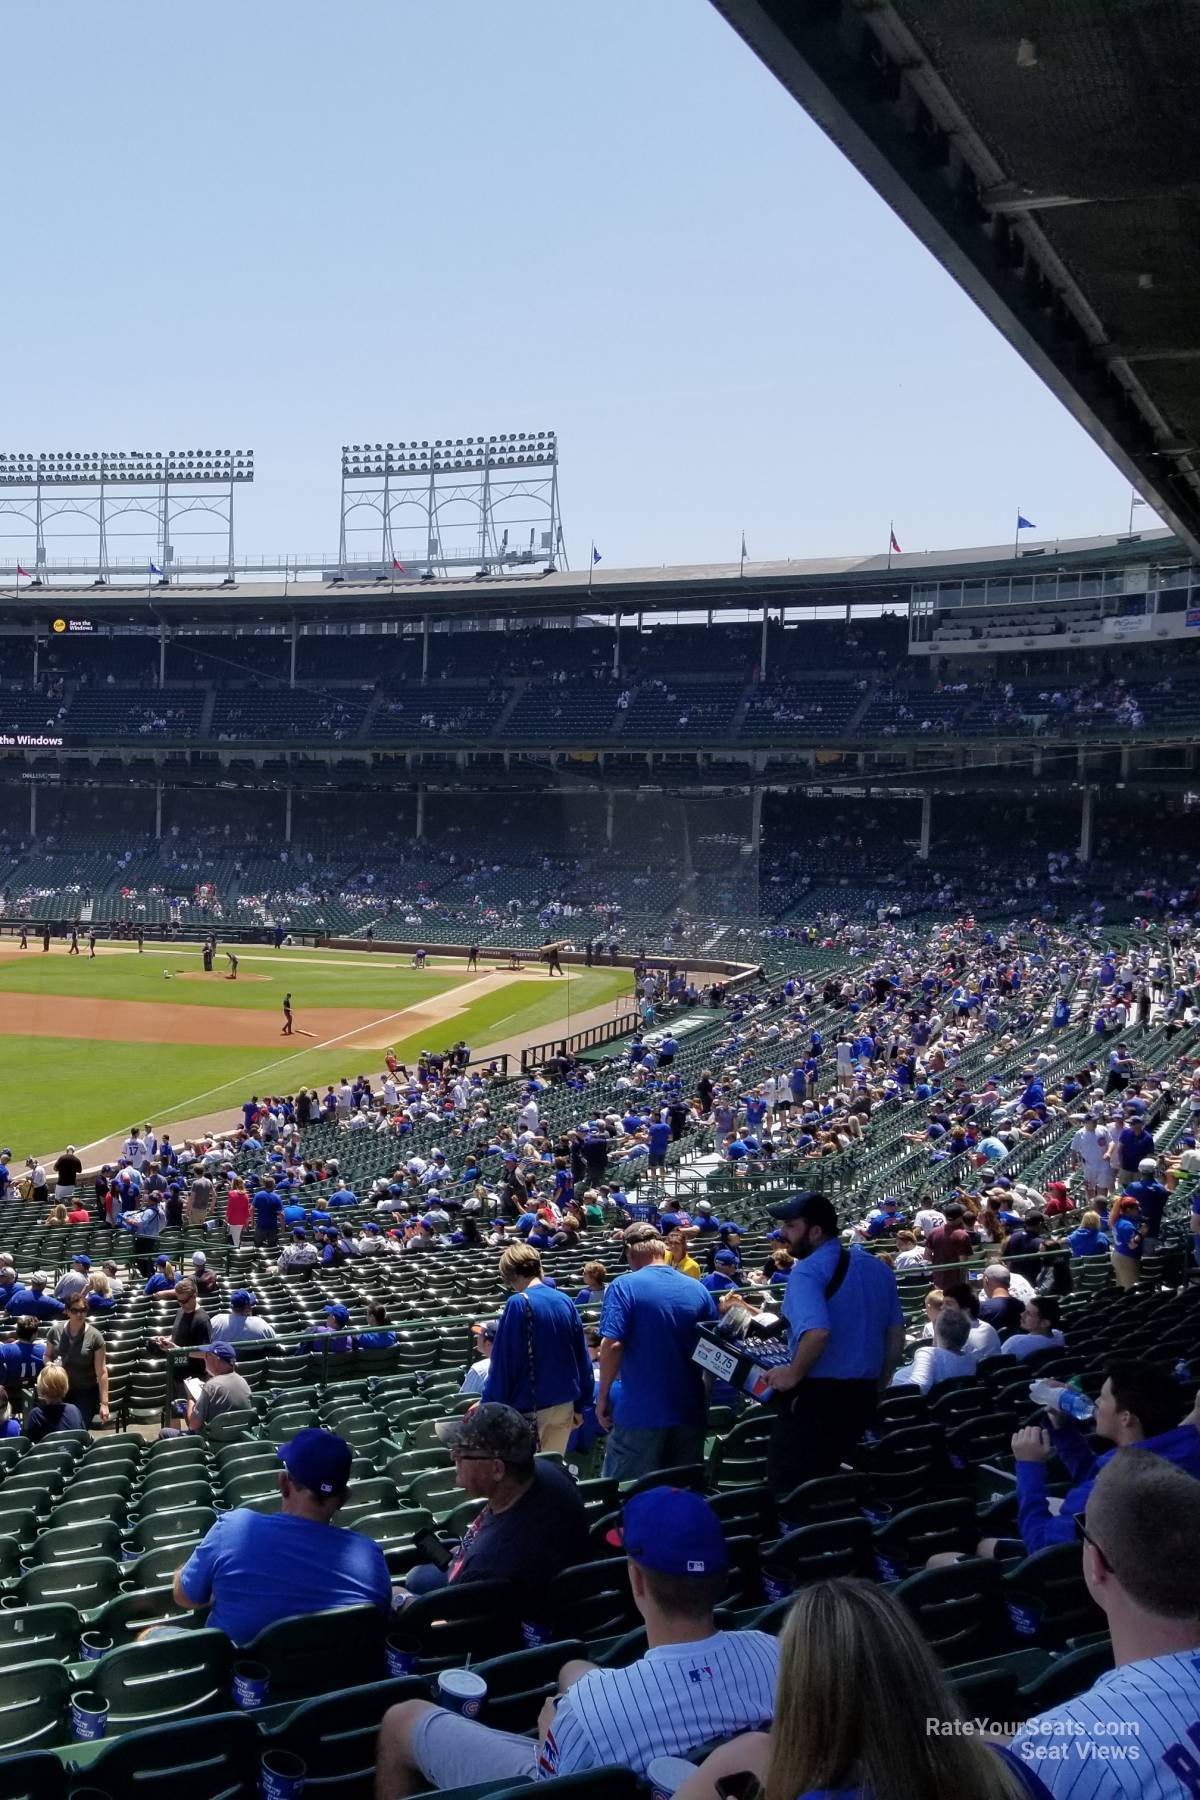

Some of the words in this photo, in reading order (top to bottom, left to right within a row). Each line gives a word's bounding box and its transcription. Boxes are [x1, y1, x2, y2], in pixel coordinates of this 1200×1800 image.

[17, 736, 63, 746] Windows
[714, 1351, 734, 1369] 9.75
[21, 1362, 37, 1378] 11
